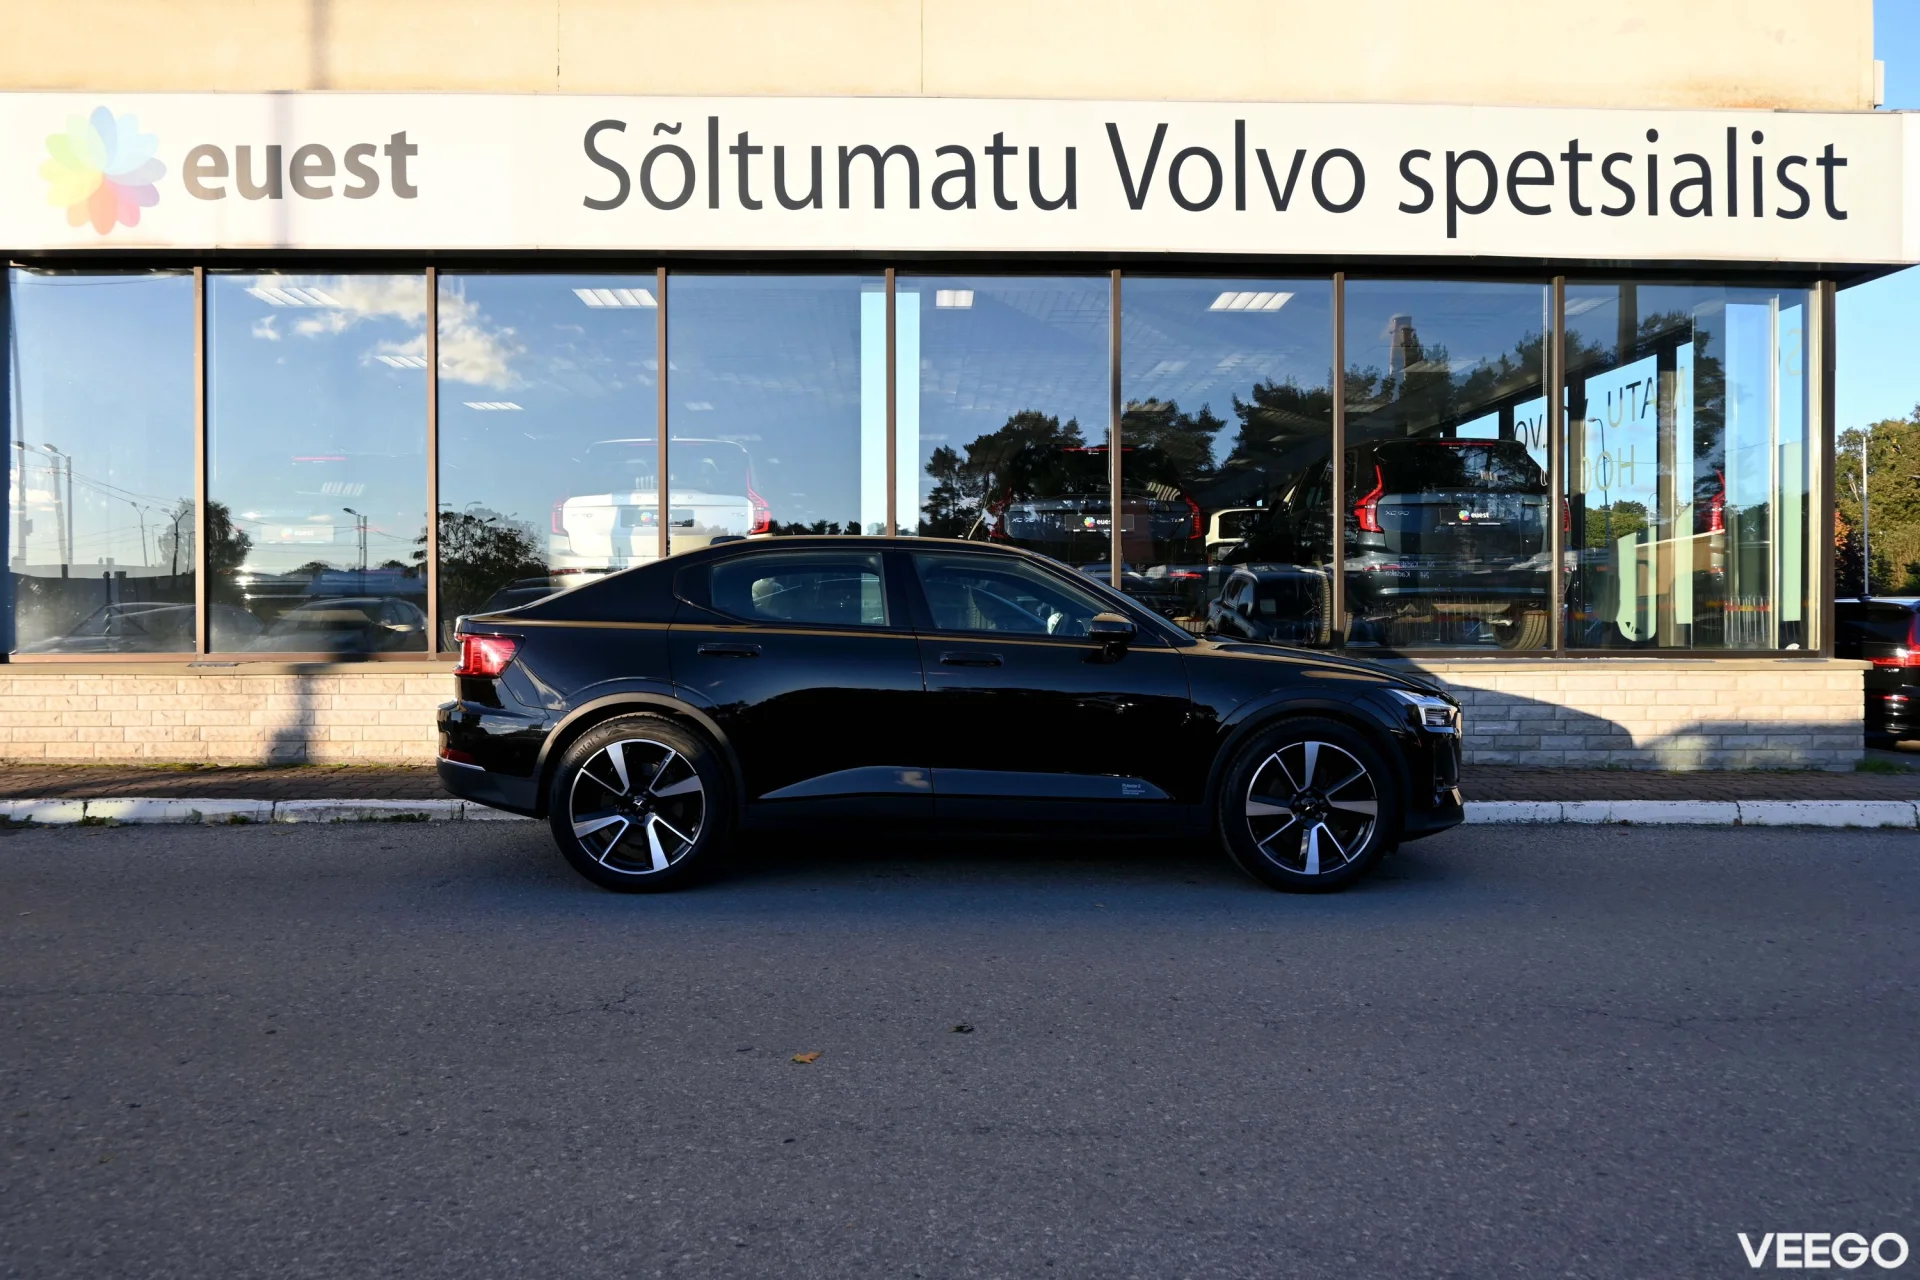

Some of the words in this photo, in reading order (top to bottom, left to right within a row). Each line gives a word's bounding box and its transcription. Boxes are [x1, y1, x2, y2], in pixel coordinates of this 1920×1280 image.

[182, 130, 419, 201] euest
[584, 116, 1077, 212] Sõltumatu
[1104, 119, 1367, 214] Volvo
[1399, 127, 1849, 239] spetsialist
